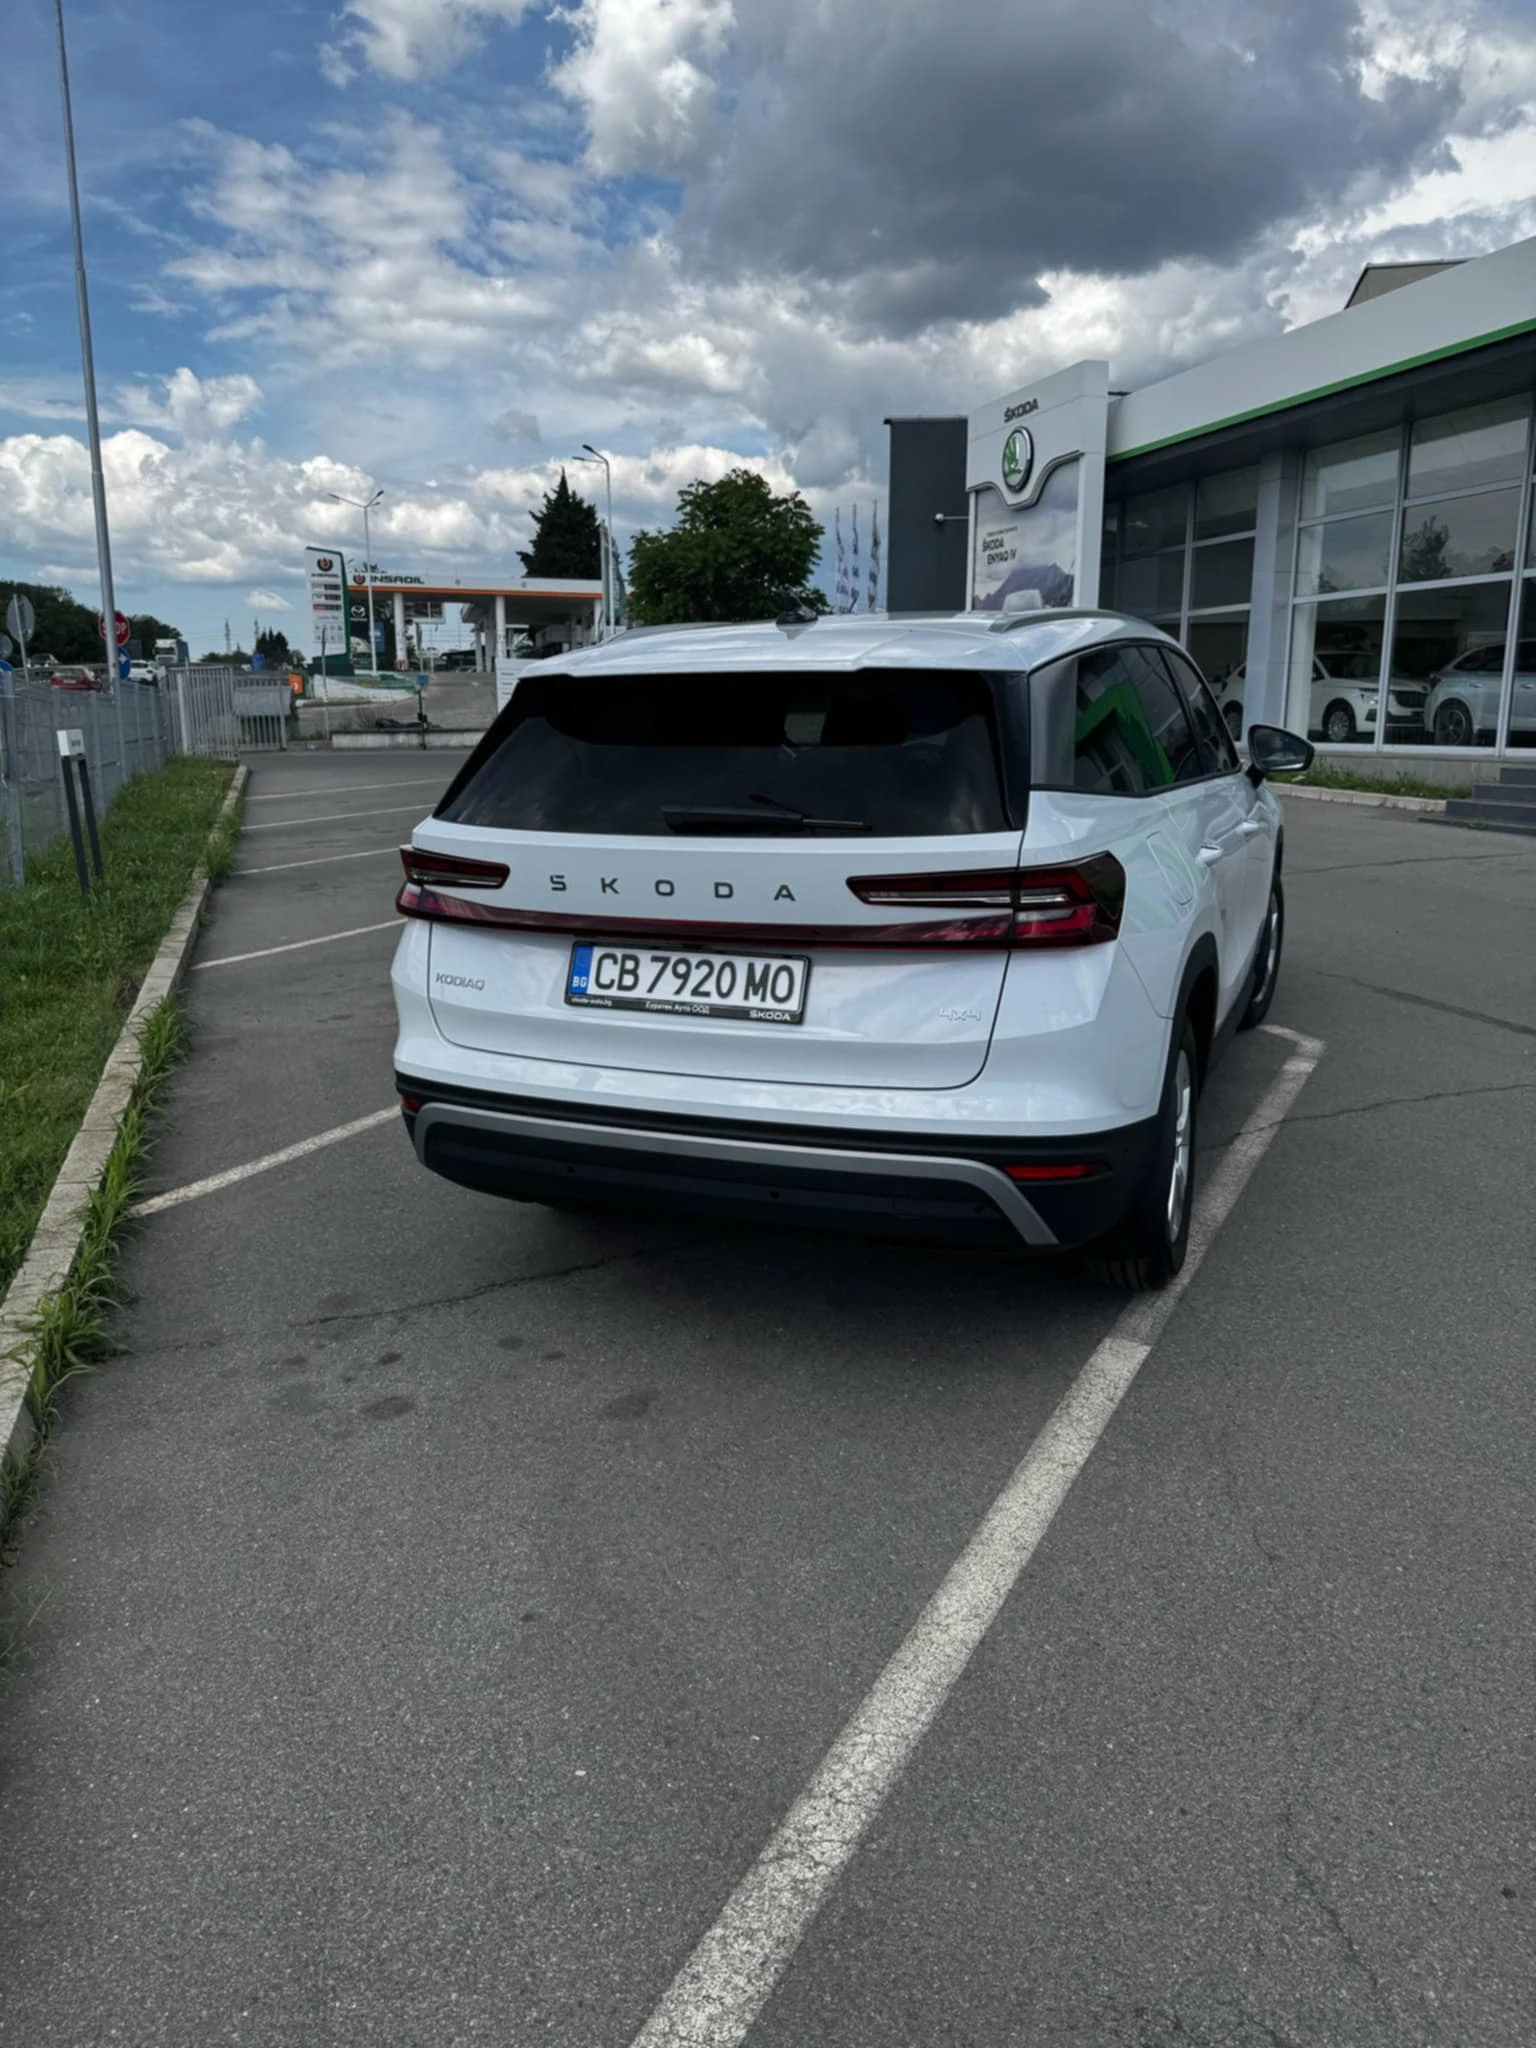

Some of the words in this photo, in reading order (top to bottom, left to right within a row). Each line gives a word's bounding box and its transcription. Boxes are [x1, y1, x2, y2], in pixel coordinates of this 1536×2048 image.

[435, 971, 486, 991] KODIAQ
[572, 976, 588, 988] BG
[595, 953, 640, 992] CB
[646, 955, 738, 999] 7920
[743, 962, 795, 1004] MO
